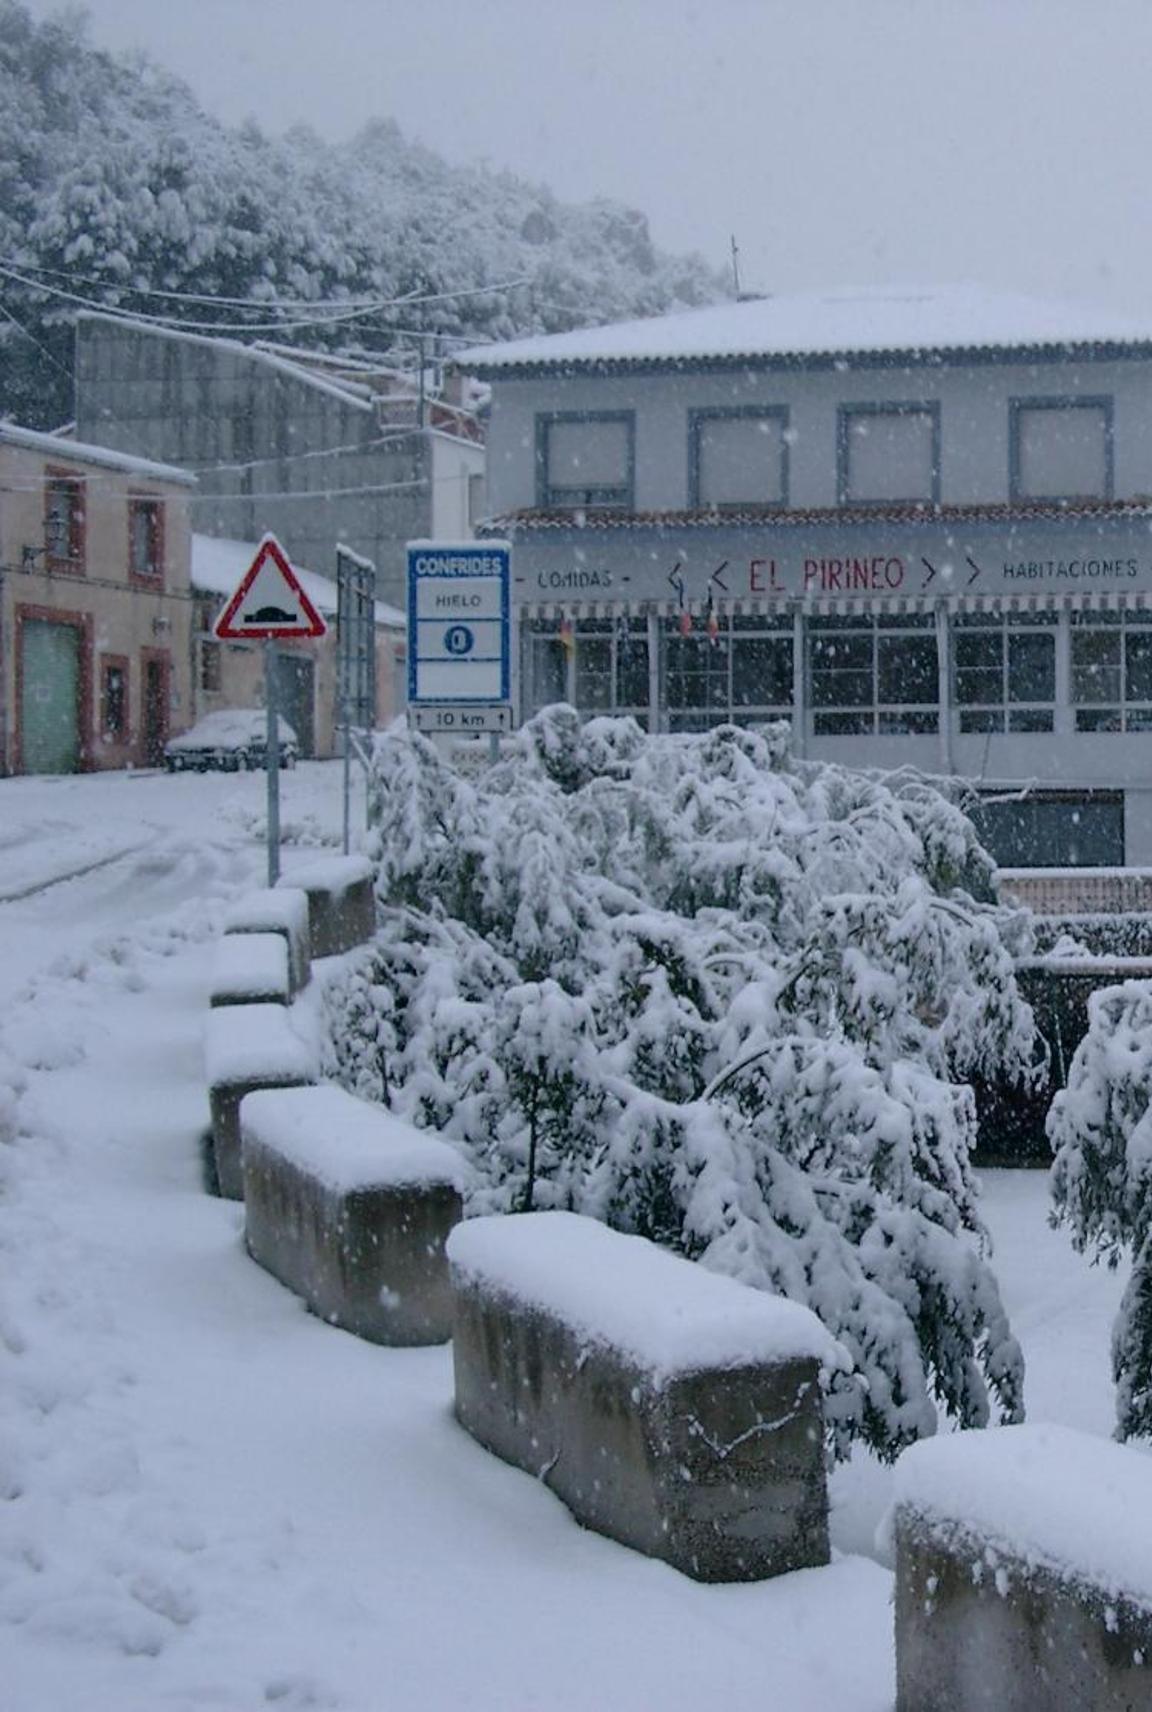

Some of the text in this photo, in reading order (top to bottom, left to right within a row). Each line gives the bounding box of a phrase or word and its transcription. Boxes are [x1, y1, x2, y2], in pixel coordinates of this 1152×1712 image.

[417, 558, 502, 575] CONFRIDES
[750, 560, 786, 592] EL
[804, 557, 905, 591] PIRINEO
[1003, 560, 1138, 580] HABITACIONES
[435, 594, 482, 607] HIELO
[437, 711, 485, 726] 10 km
